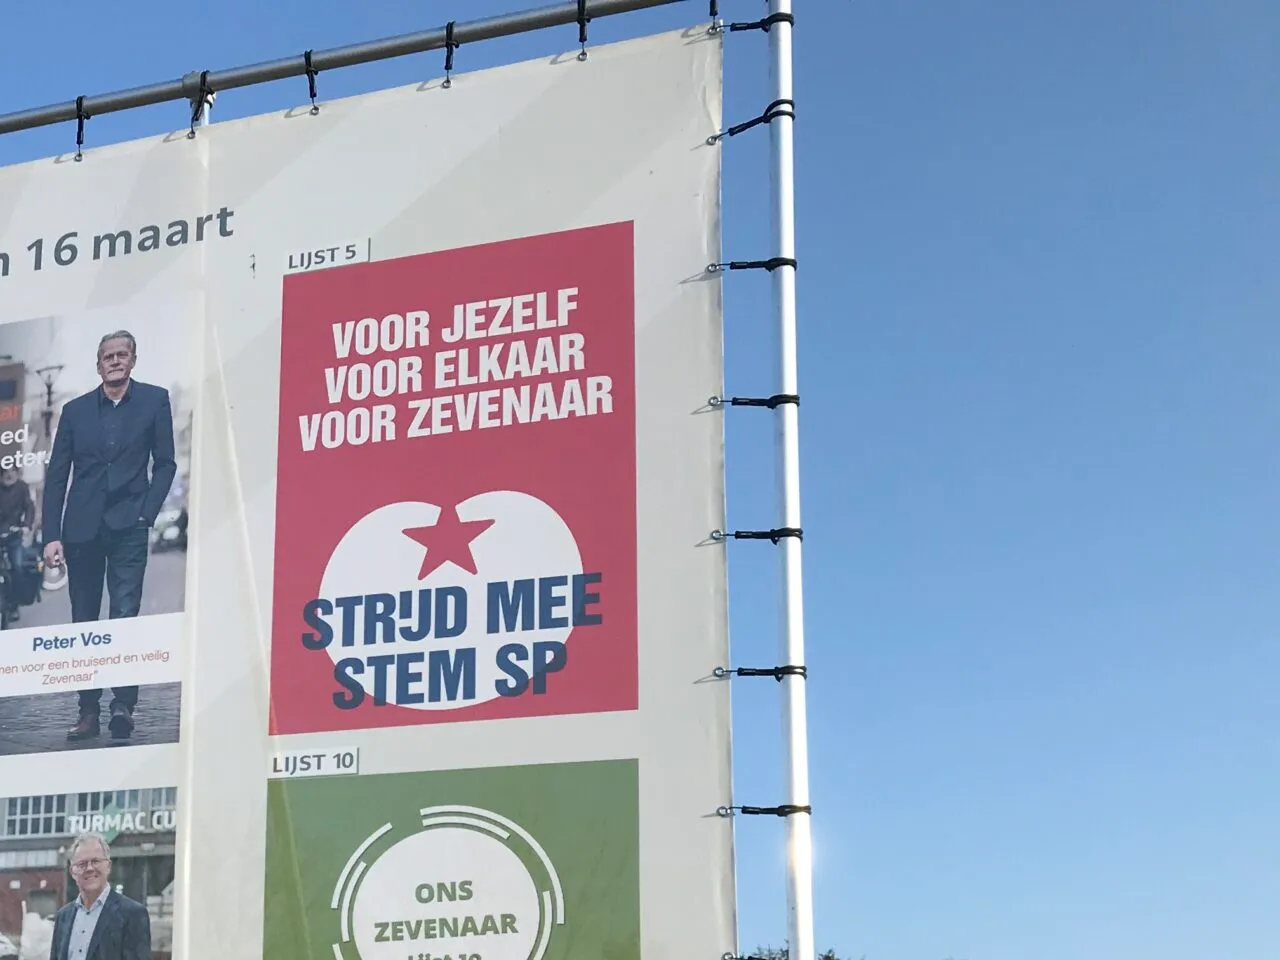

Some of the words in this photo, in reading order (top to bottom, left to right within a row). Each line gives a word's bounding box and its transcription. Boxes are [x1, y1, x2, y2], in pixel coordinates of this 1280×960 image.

[27, 231, 78, 270] 16
[92, 206, 234, 260] maart
[288, 246, 340, 270] LIJST
[345, 244, 357, 260] 5
[332, 310, 430, 359] VOOR
[441, 287, 578, 343] JEZELF
[324, 355, 422, 404] VOOR
[435, 333, 585, 389] ELKAAR
[298, 404, 395, 452] VOOR
[407, 375, 613, 438] ZEVENAAR
[301, 585, 468, 651] STRIJD
[486, 572, 602, 634] MEE
[32, 635, 76, 651] Peter
[81, 632, 112, 646] Vos
[21, 663, 46, 673] voor
[48, 660, 70, 670] een
[72, 654, 120, 669] bruisend
[124, 655, 138, 664] en
[141, 650, 170, 662] veilig
[332, 647, 476, 710] STEM
[494, 640, 567, 697] SP
[42, 670, 98, 685] Zevenaar"
[272, 754, 326, 775] LIJST
[333, 752, 355, 769] 10
[68, 812, 146, 834] TURMAC
[415, 880, 473, 904] ONS
[374, 913, 519, 943] ZEVENAAR
